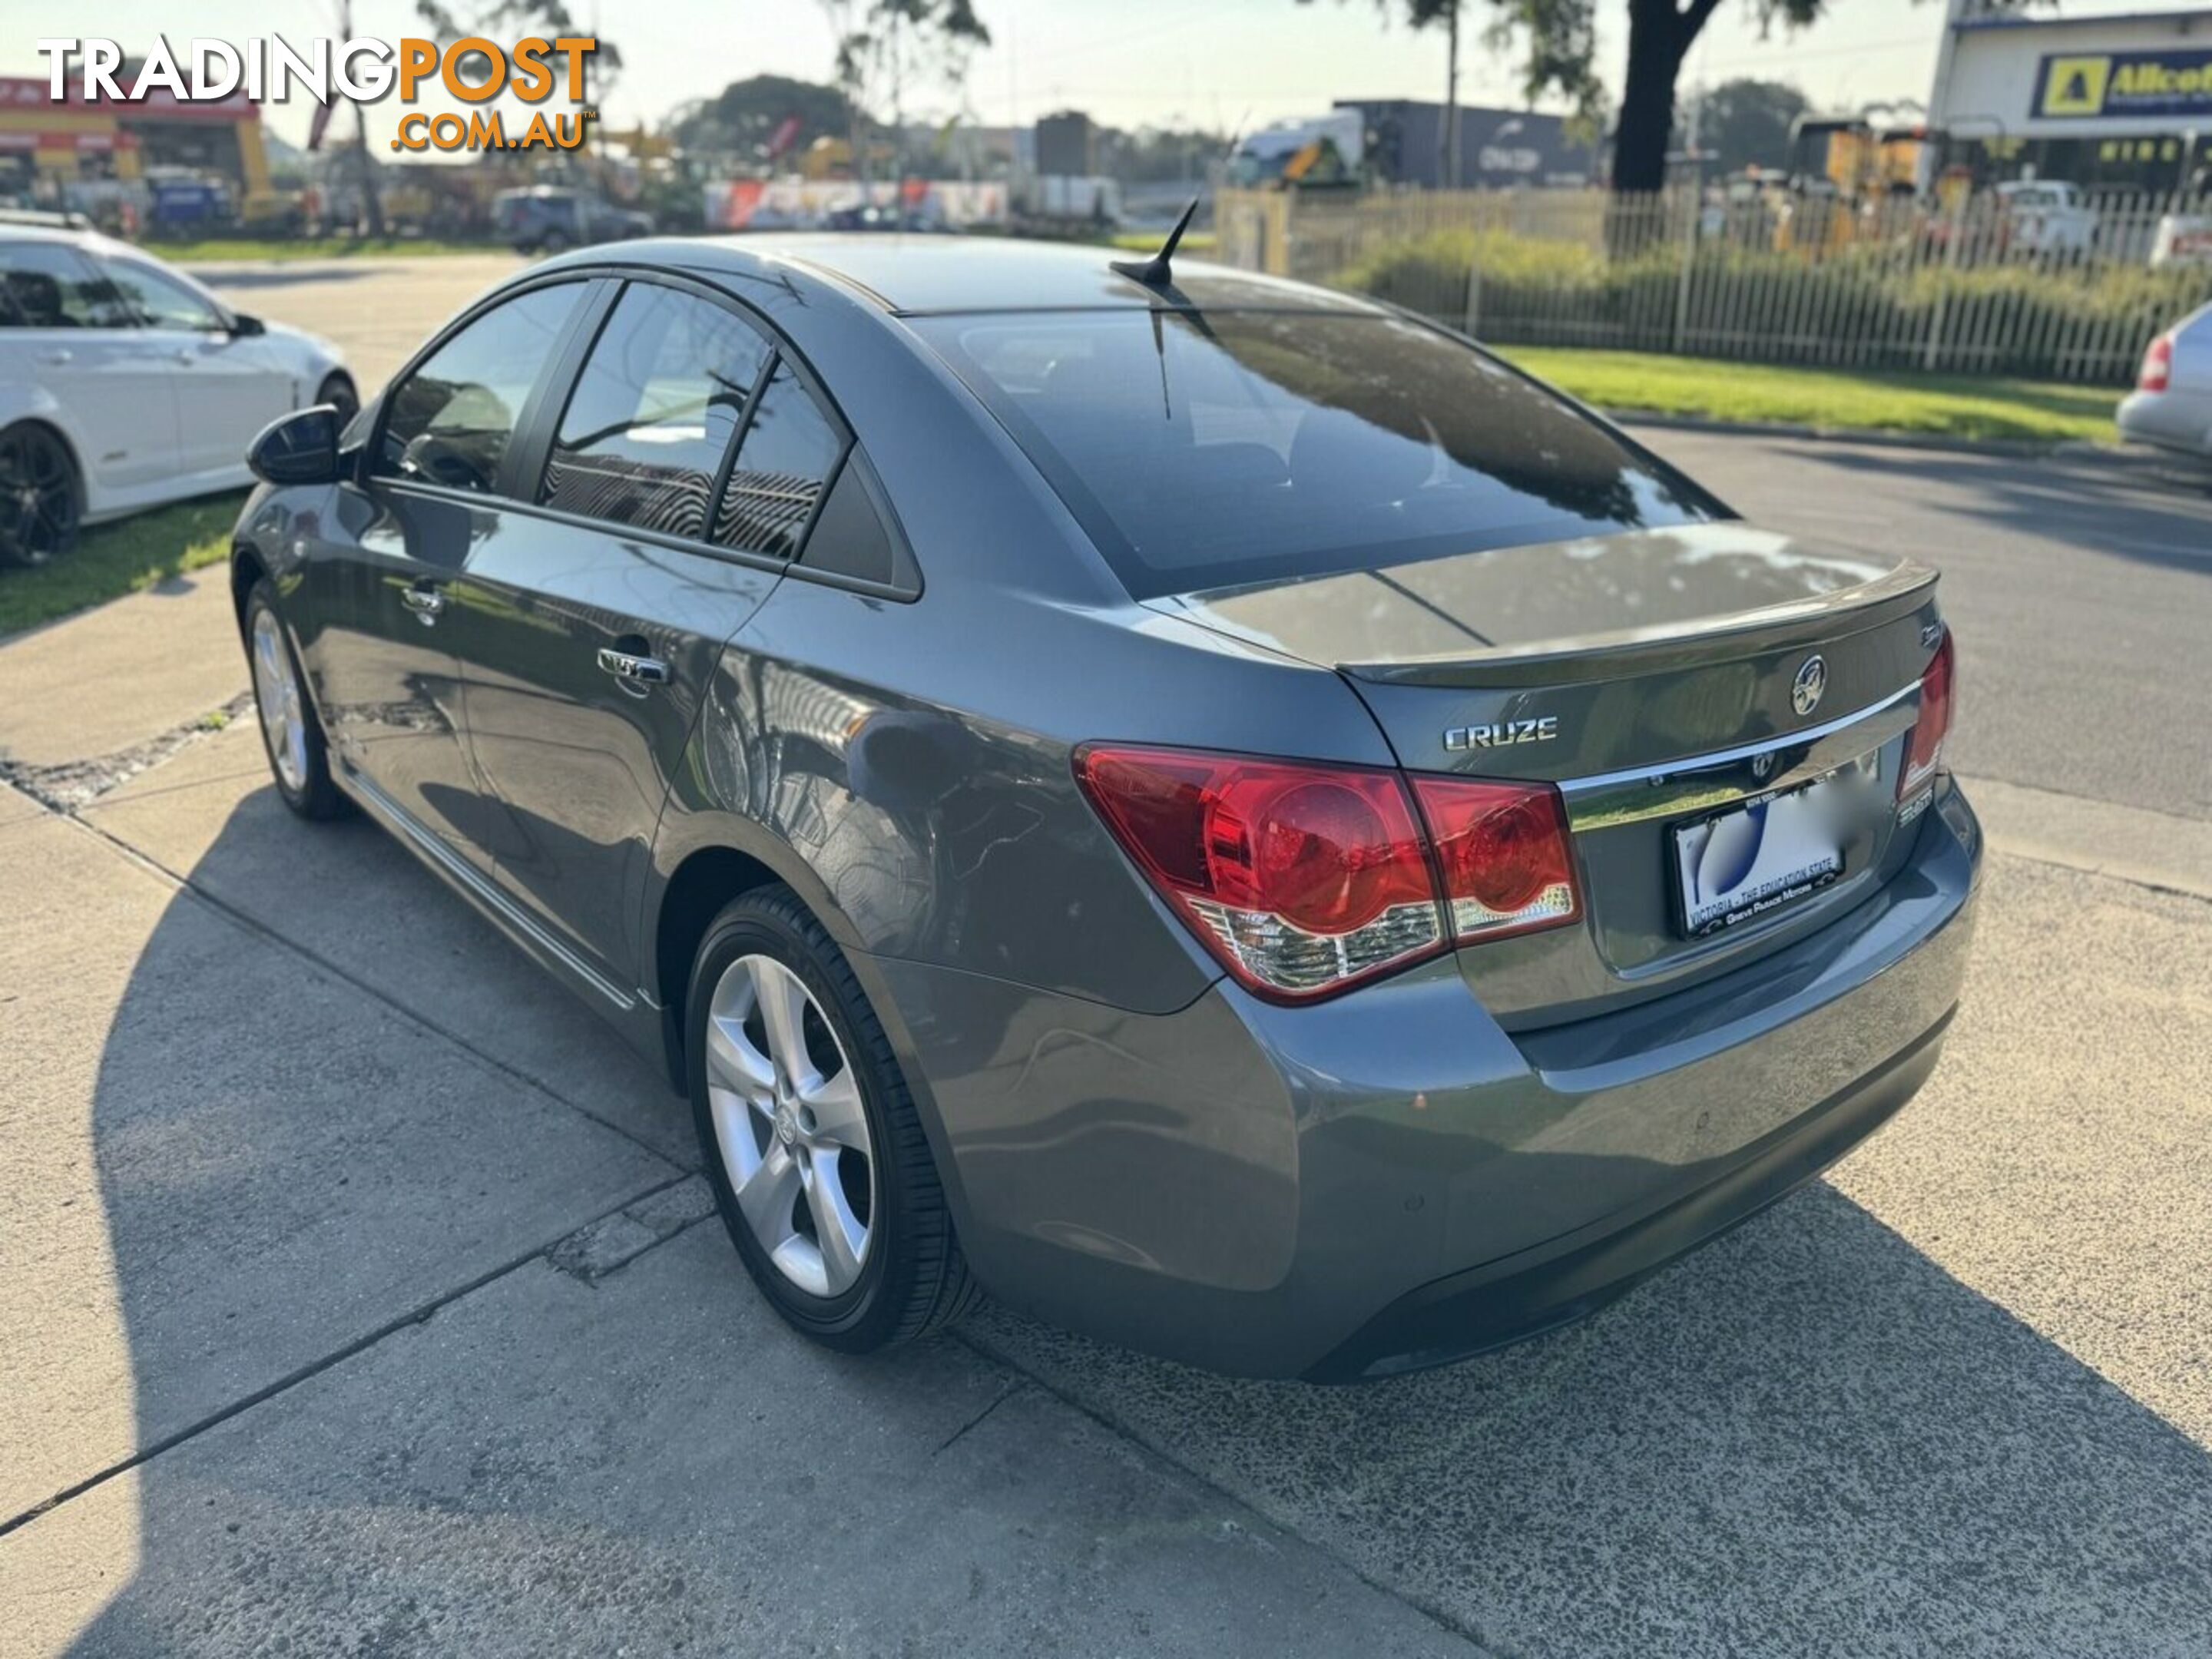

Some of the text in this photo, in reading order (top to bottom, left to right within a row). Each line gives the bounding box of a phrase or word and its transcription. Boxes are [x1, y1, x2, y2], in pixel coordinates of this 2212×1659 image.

[1444, 717, 1558, 750] CRUZE
[1690, 899, 1733, 926] VICTORIA
[1741, 889, 1758, 902] THE
[1760, 869, 1806, 896] EDUCATION
[1809, 857, 1833, 875] STATE
